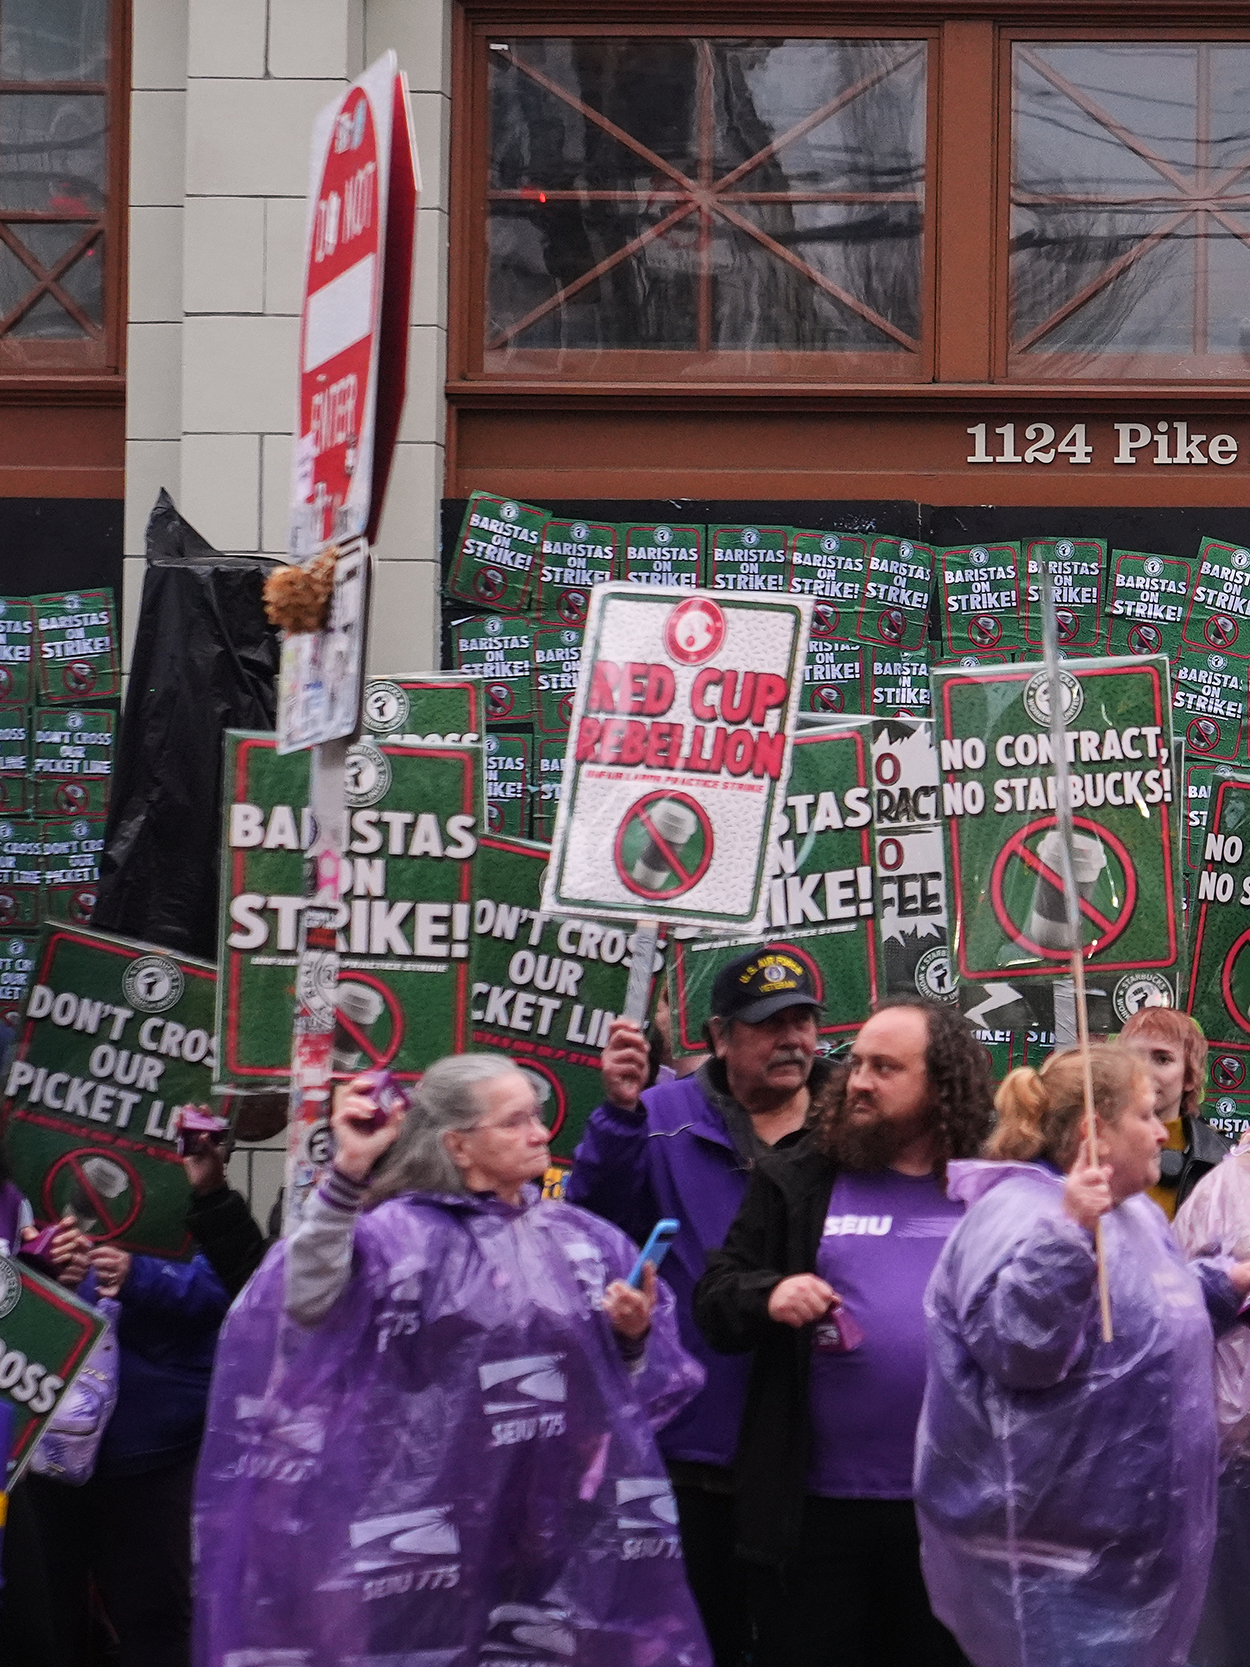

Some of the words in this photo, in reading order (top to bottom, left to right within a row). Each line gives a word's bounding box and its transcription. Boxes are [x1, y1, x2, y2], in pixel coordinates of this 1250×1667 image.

[966, 422, 1093, 464] 1124
[1113, 420, 1239, 465] Pike
[469, 513, 538, 544] BARISTAS
[491, 535, 512, 549] ON
[541, 541, 614, 560] BARISTAS
[462, 539, 534, 572] STRIKE!
[567, 556, 587, 569] ON
[627, 545, 699, 562] BARISTAS
[714, 549, 785, 563] BARISTAS
[792, 552, 864, 571] BARISTAS
[652, 560, 673, 573] ON
[740, 562, 758, 574] ON
[817, 568, 836, 580] ON
[945, 566, 1016, 584] BARISTAS
[627, 571, 698, 587] STRIKE!
[714, 574, 784, 591] STRIKE!
[790, 578, 859, 599] STRIKE!
[971, 582, 991, 593] ON
[1054, 575, 1073, 586] ON
[1116, 574, 1187, 595] BARISTAS
[1140, 591, 1159, 603] ON
[1223, 584, 1243, 596] ON
[948, 591, 1017, 612] STRIKE!
[1112, 600, 1183, 622] STRIKE!
[38, 612, 110, 631] BARISTAS
[42, 637, 111, 659] STRIKE!
[458, 636, 530, 651] BARISTAS
[485, 650, 504, 662] ON
[816, 652, 834, 663] ON
[805, 662, 860, 680] TRIKE!
[588, 660, 676, 717] RED
[691, 667, 788, 727] CUP
[1202, 685, 1221, 698] ON
[1174, 692, 1242, 718] STRIKE!
[575, 717, 786, 780] REBELLION
[941, 737, 986, 771] NO
[995, 726, 1170, 768] CONTRACT,
[942, 781, 985, 816] NO
[230, 803, 477, 860] BASTAS
[1204, 833, 1243, 863] NO
[1198, 870, 1234, 903] NO
[474, 899, 550, 946] ON'T
[508, 950, 583, 996] OUR
[27, 984, 134, 1041] DON'T
[471, 983, 562, 1036] CKET
[89, 1044, 165, 1092] OUR
[5, 1060, 141, 1129] PICKET
[823, 1214, 893, 1237] SEIU
[490, 1418, 537, 1447] SEIU
